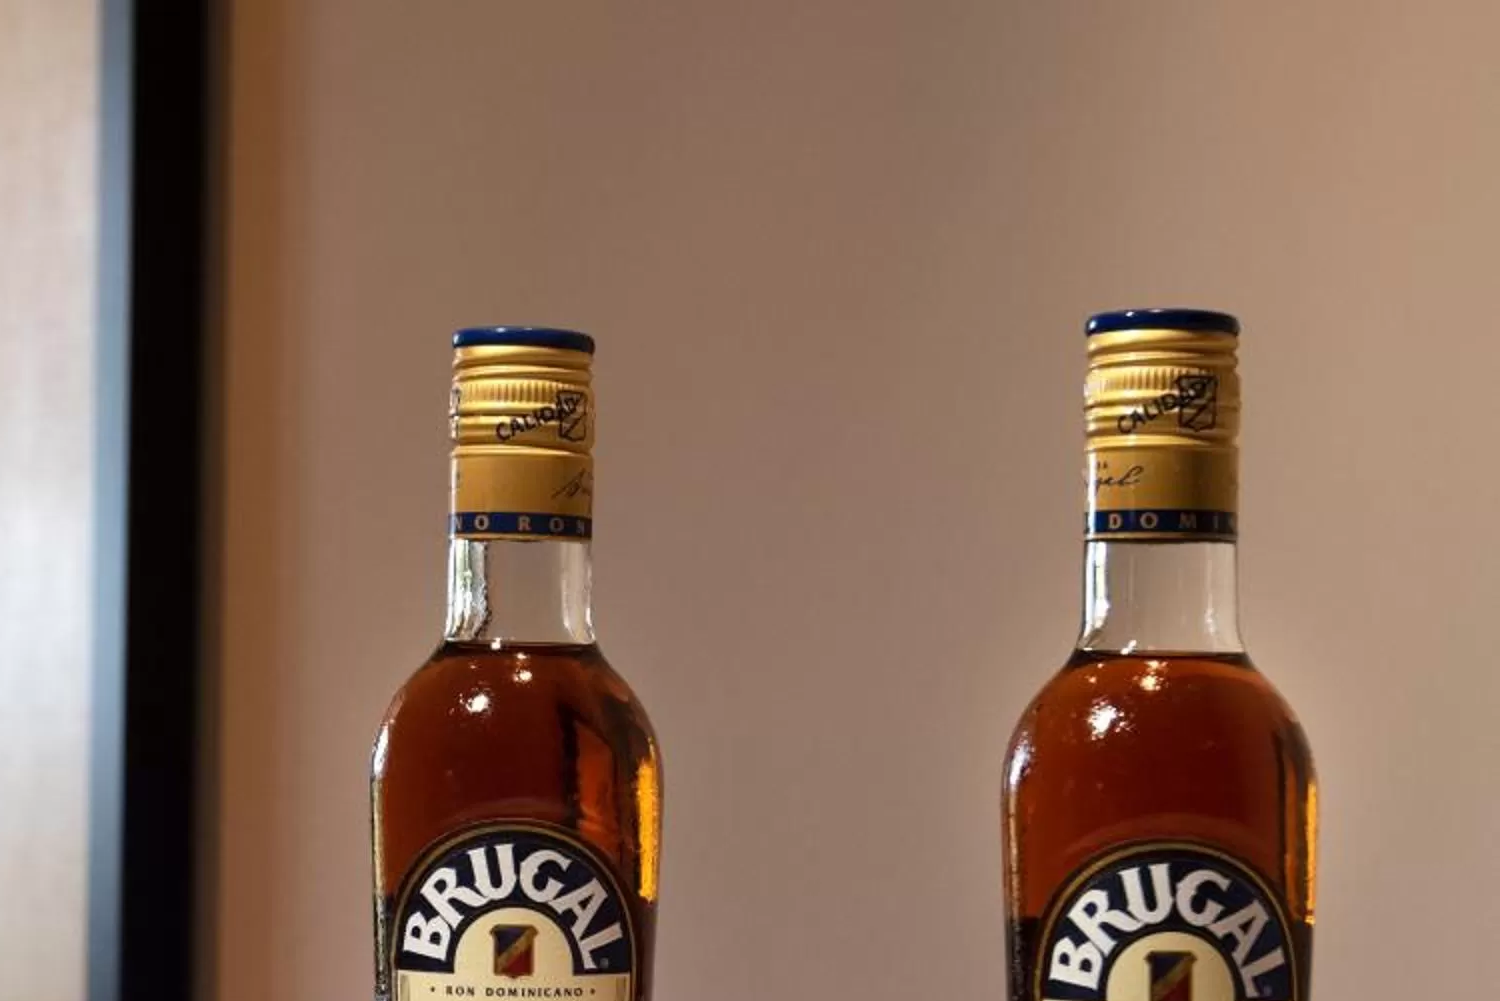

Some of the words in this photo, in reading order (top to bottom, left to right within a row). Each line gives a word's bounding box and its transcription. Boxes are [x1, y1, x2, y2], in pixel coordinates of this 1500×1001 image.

[402, 843, 624, 970] BRUGAL
[1048, 862, 1287, 998] BRUGAL
[445, 985, 475, 998] RON
[485, 986, 584, 998] DOMINICANO
